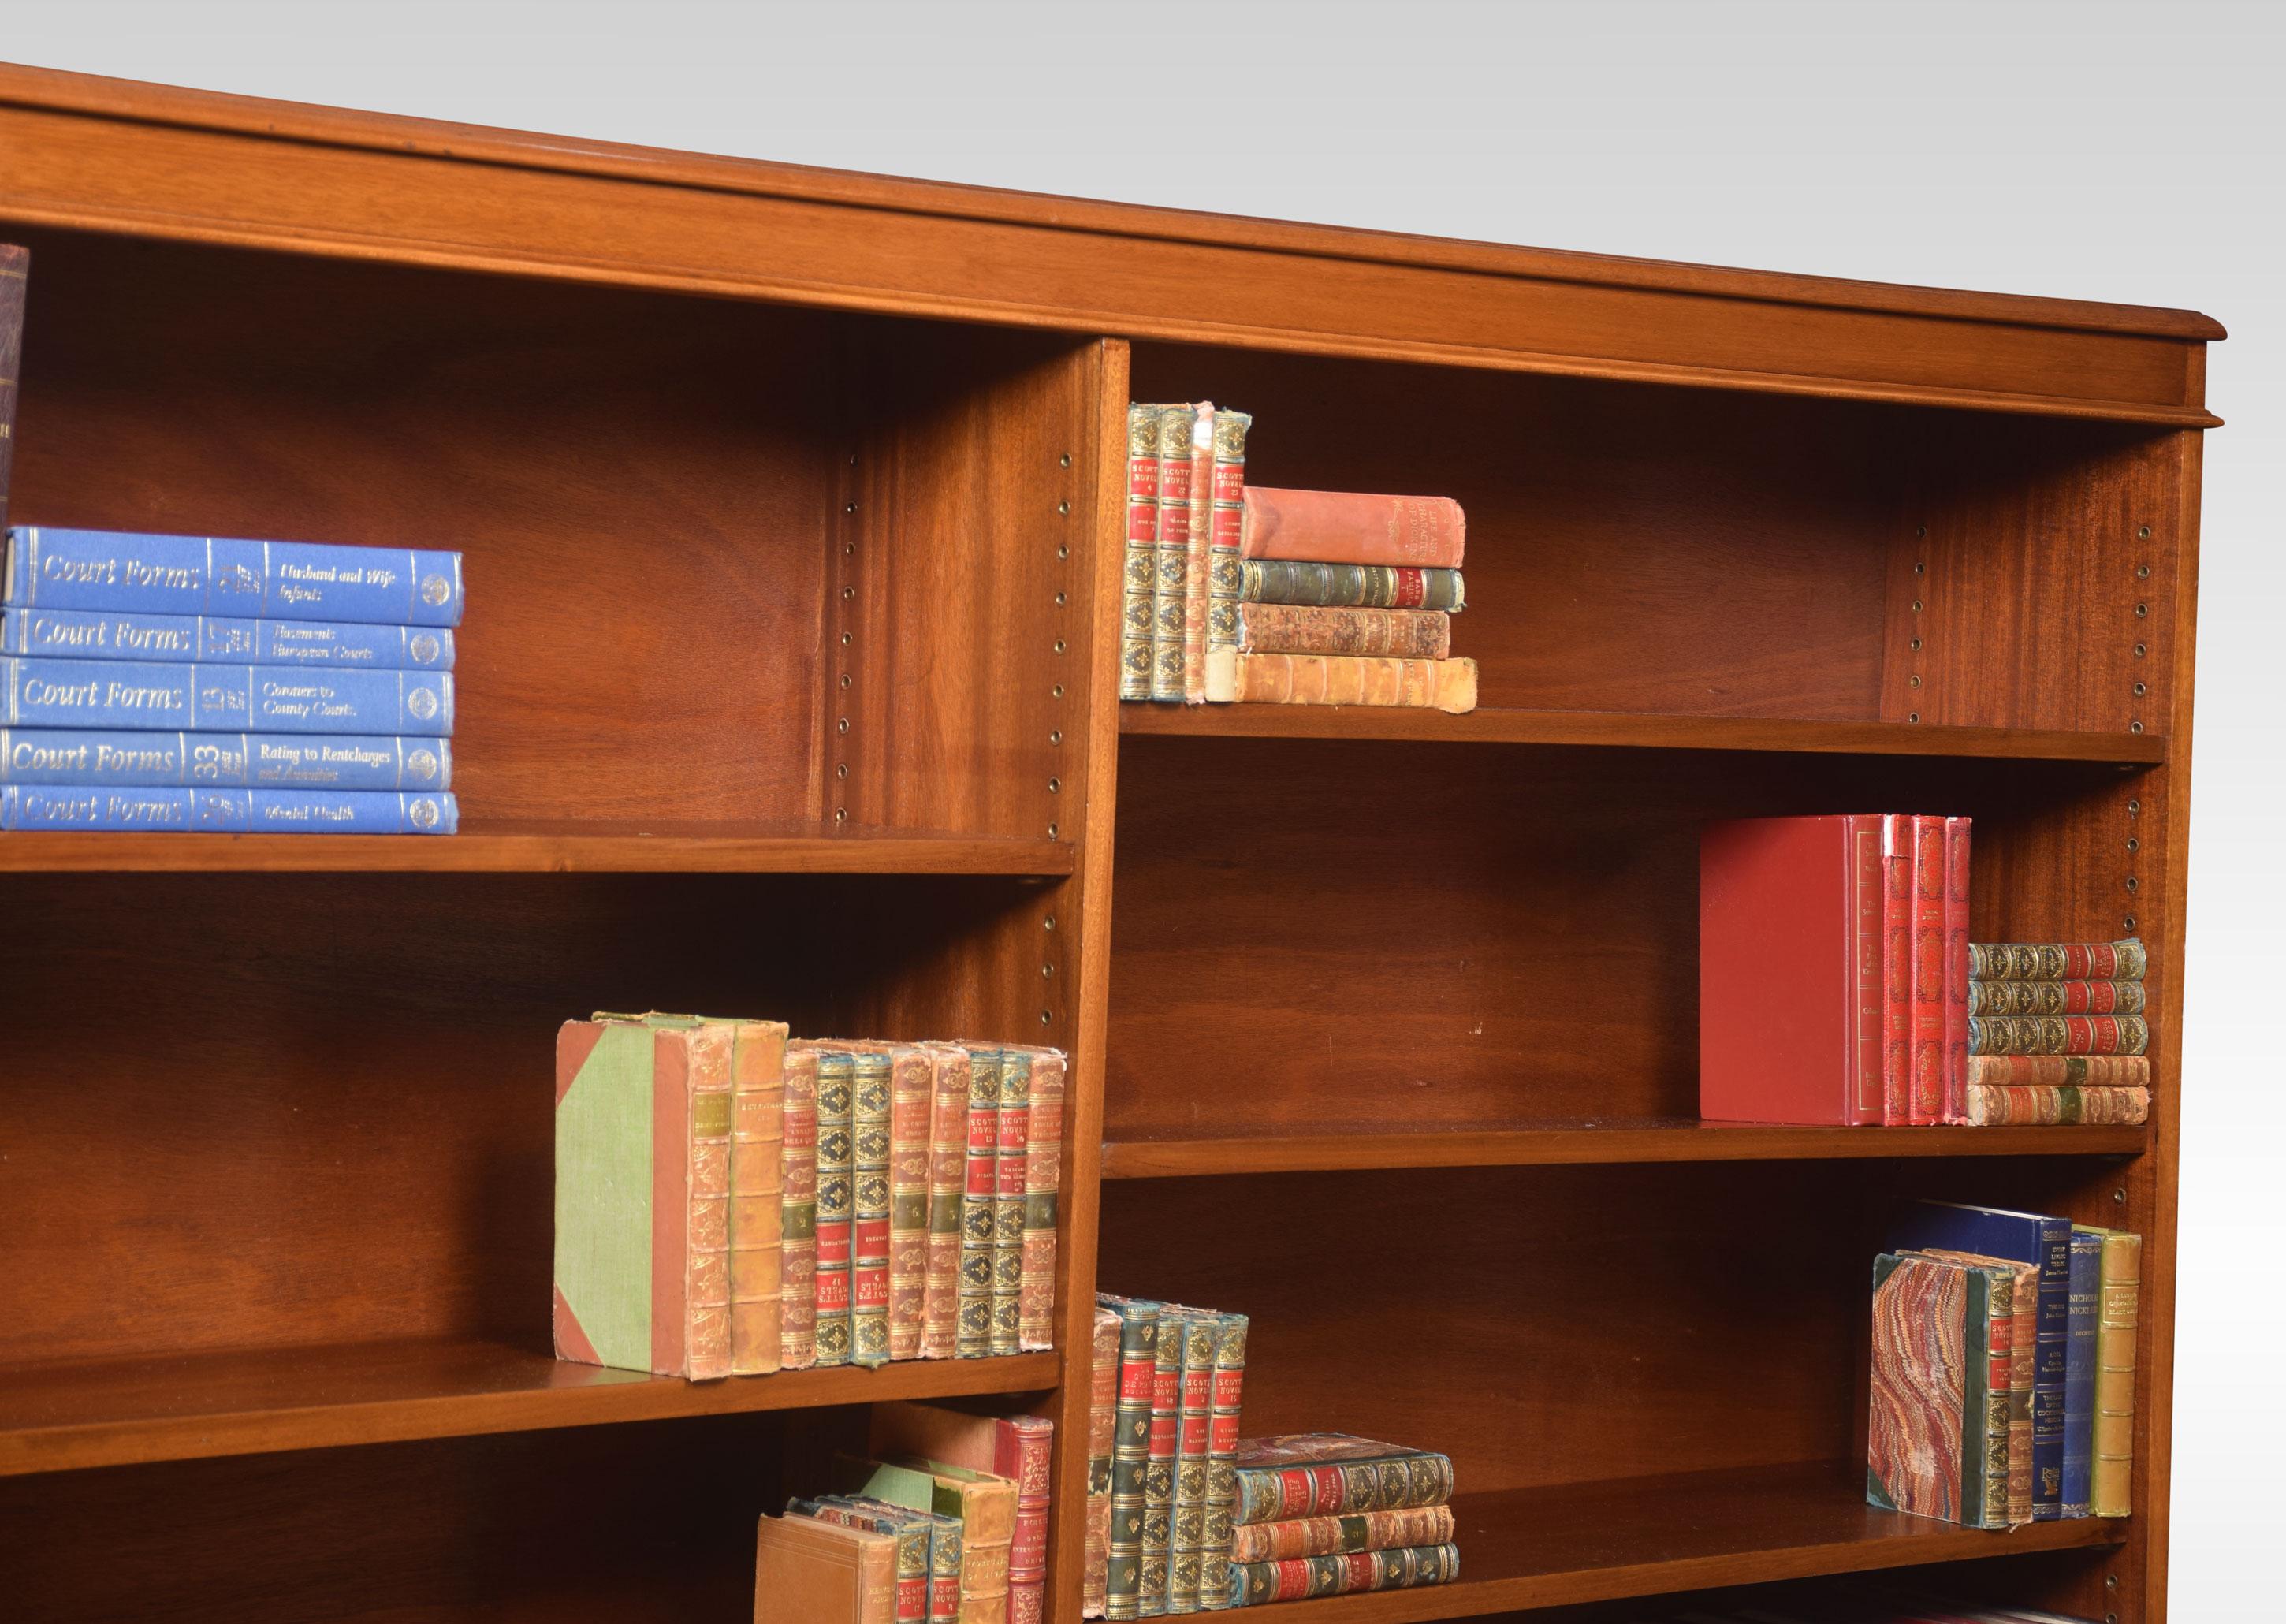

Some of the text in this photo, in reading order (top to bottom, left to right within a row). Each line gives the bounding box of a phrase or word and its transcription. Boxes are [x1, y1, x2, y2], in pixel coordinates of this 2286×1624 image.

[1409, 504, 1419, 562] OF DICKENS
[1418, 503, 1428, 563] CHARACTERS
[1429, 511, 1438, 532] LIFE
[44, 554, 199, 589] Court Forms
[219, 564, 240, 593] 21
[281, 563, 336, 583] Husband
[339, 568, 363, 583] and
[367, 569, 396, 589] Wife
[279, 584, 322, 604] Infants
[35, 618, 191, 650] Court Forms
[208, 623, 229, 654] 17
[274, 624, 336, 640] Easements
[272, 642, 373, 661] European Courts
[24, 679, 184, 709] Court Forms
[202, 687, 225, 713] 13
[262, 681, 336, 698] Coroners to
[262, 699, 310, 719] County
[12, 742, 175, 772] Court Forms
[194, 745, 220, 779] 33
[260, 743, 301, 765] Rating
[304, 747, 318, 761] to
[322, 745, 391, 768] Rentcharges
[24, 795, 181, 821] Court Forms
[265, 805, 354, 821] Mental Health
